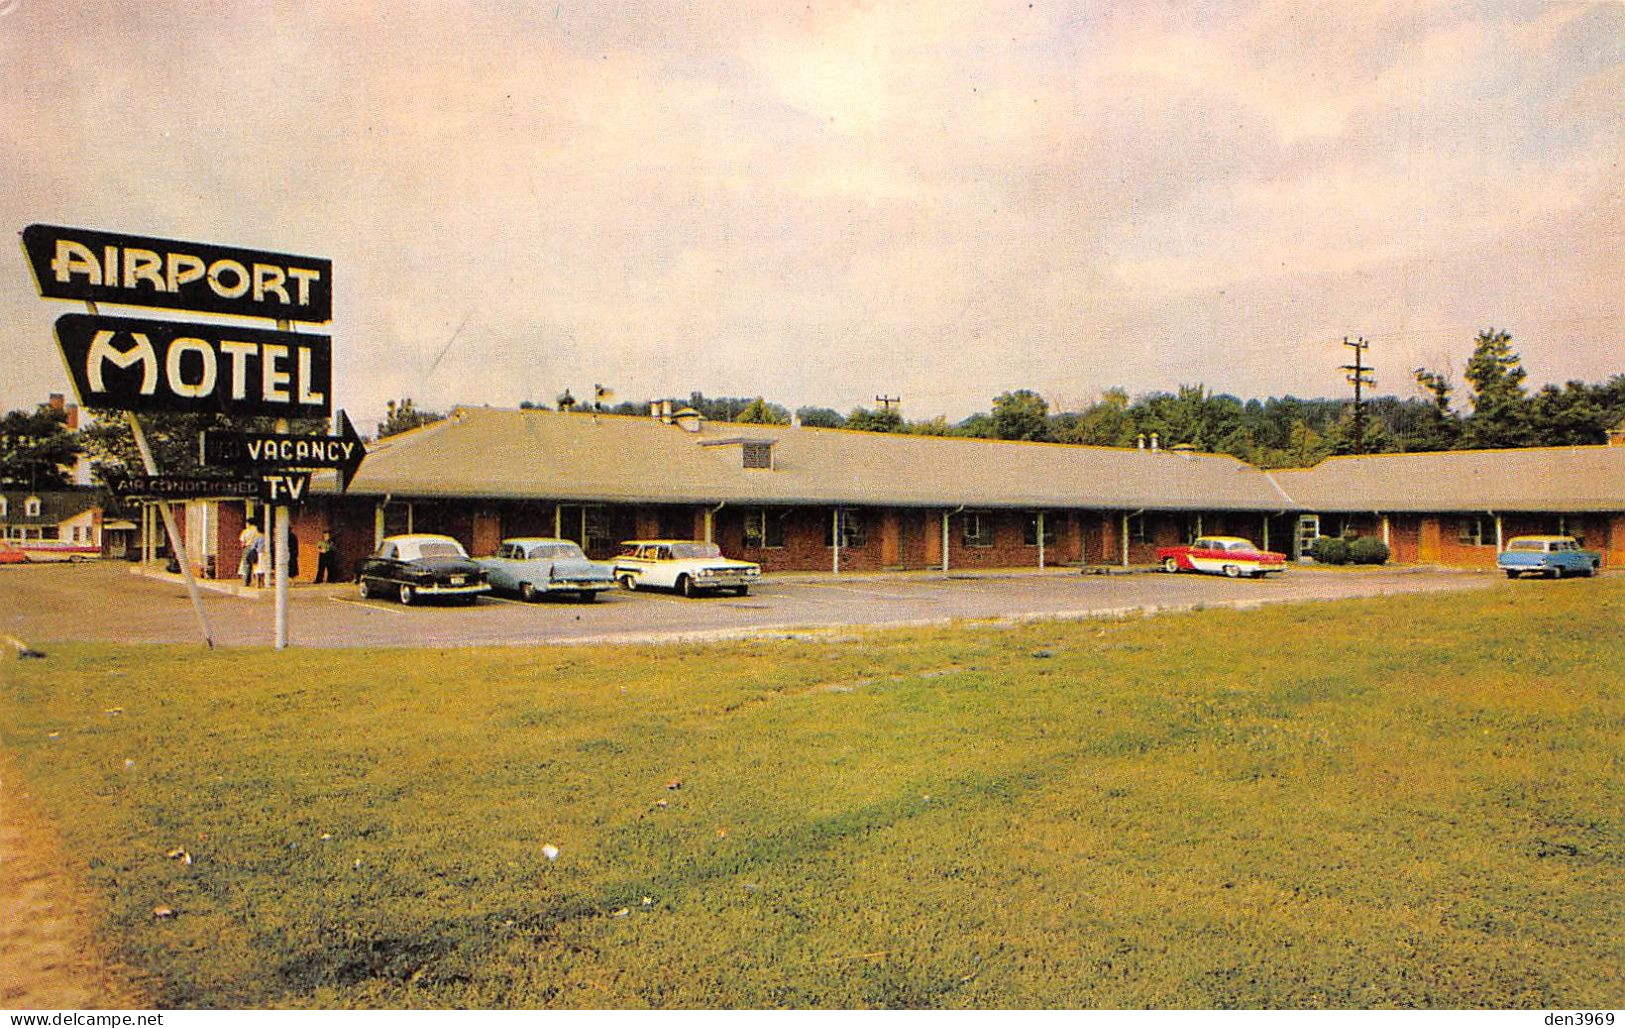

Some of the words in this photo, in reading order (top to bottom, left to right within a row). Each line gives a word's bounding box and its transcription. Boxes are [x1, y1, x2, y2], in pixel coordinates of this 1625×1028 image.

[52, 240, 320, 305] AIRPORT
[87, 331, 323, 405] MOTEL
[247, 440, 355, 461] VACANCY
[118, 479, 145, 491] AIR
[150, 479, 258, 493] CONDITIONED
